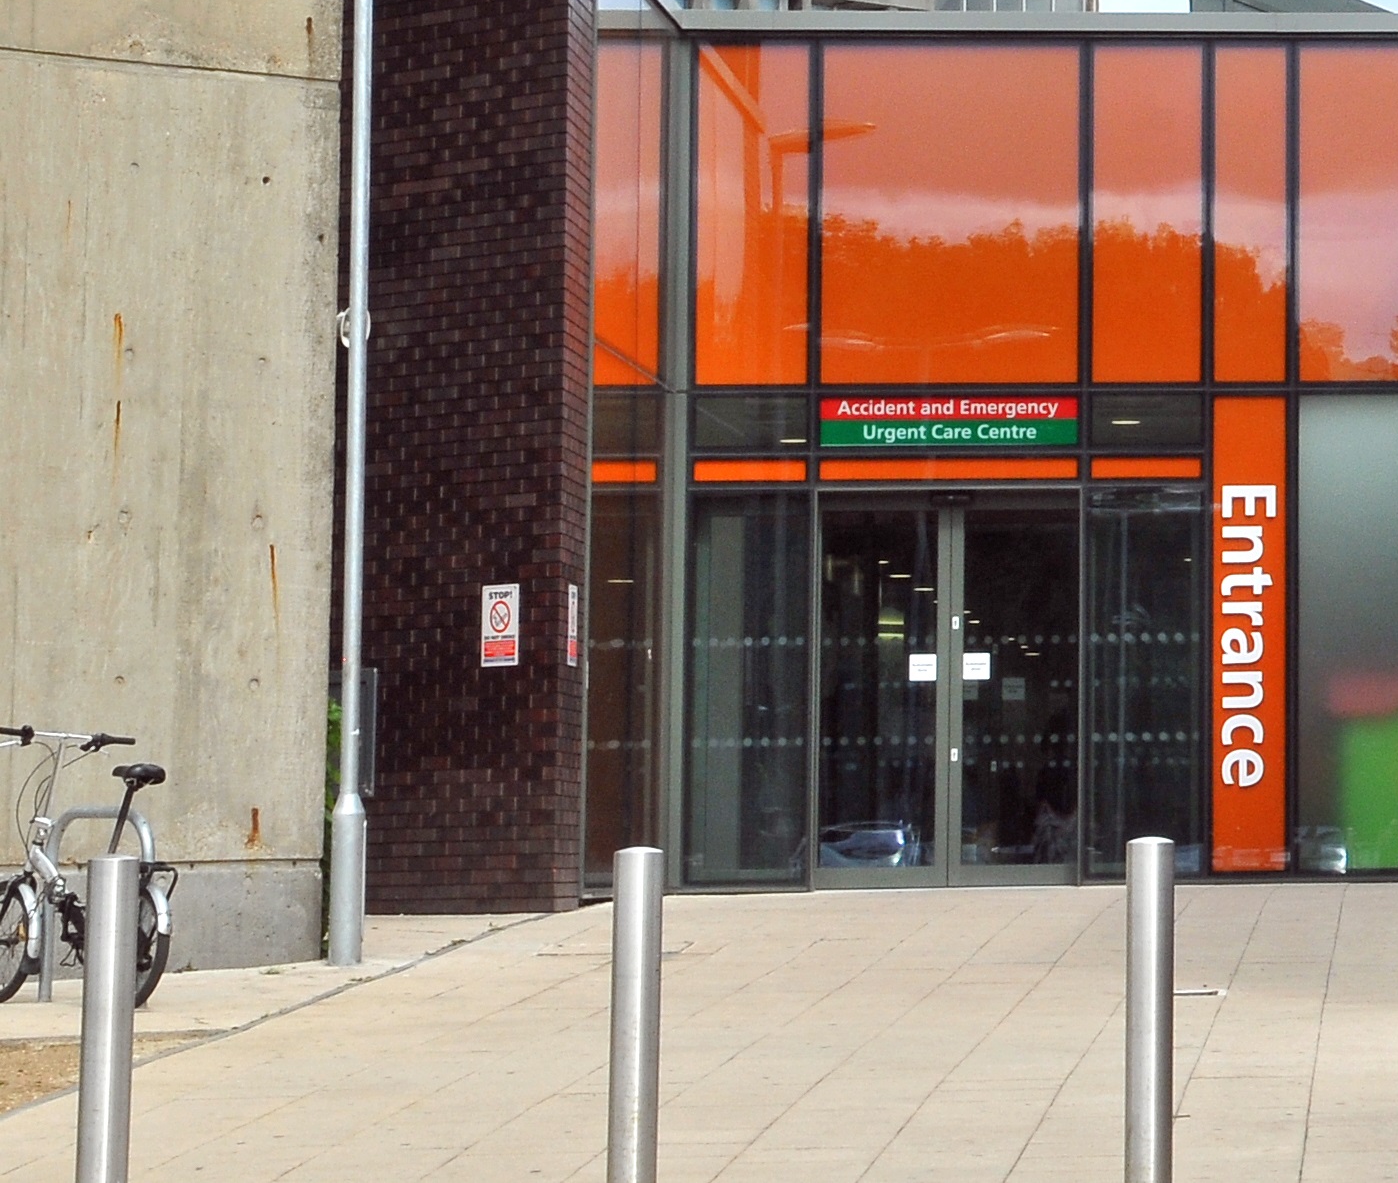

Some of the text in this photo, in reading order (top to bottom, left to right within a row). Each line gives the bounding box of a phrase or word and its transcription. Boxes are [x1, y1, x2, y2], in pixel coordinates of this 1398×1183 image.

[837, 399, 1059, 418] Accident and Emergency
[863, 423, 1037, 443] Urgent Care Centre
[1221, 484, 1277, 787] Entrance
